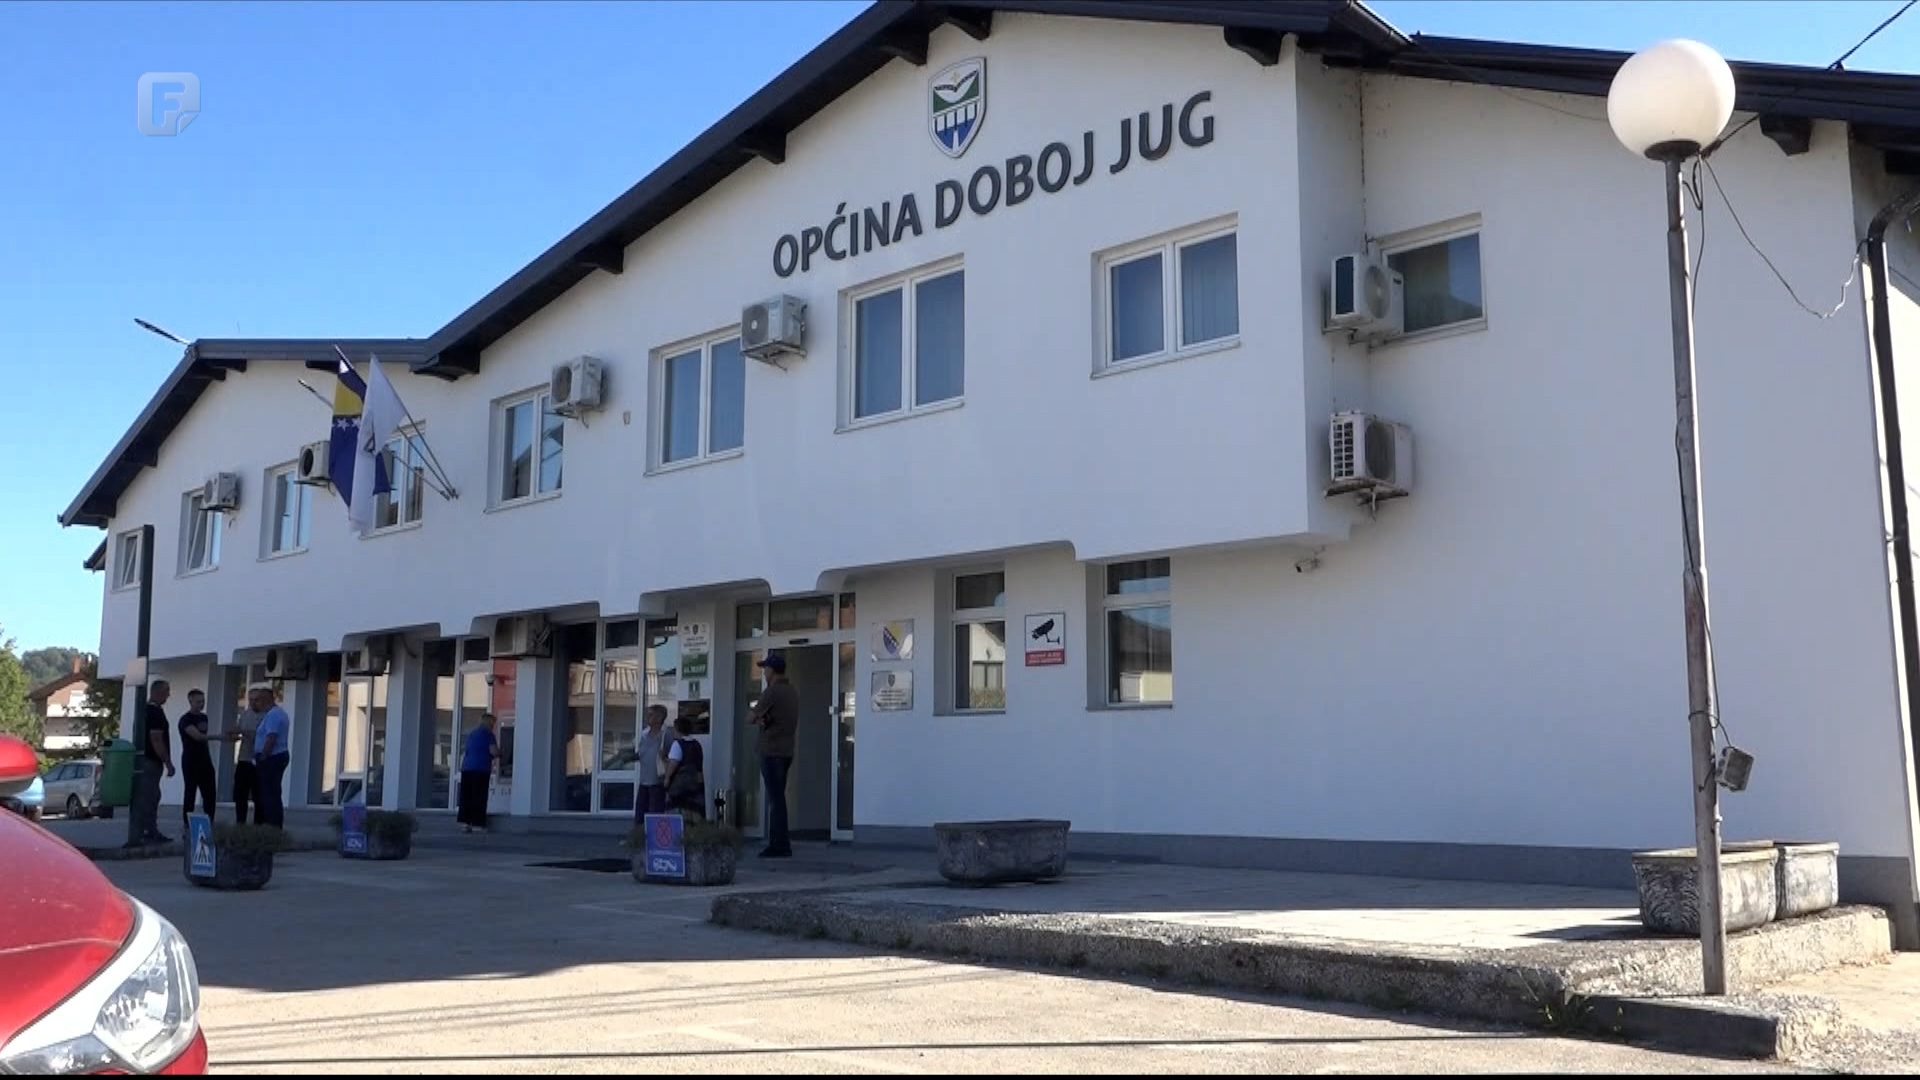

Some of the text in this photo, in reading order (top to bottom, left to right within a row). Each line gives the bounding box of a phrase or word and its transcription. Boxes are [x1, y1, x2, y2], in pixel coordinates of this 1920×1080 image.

[773, 90, 1215, 278] OPĆINA DOBOJ JUG
